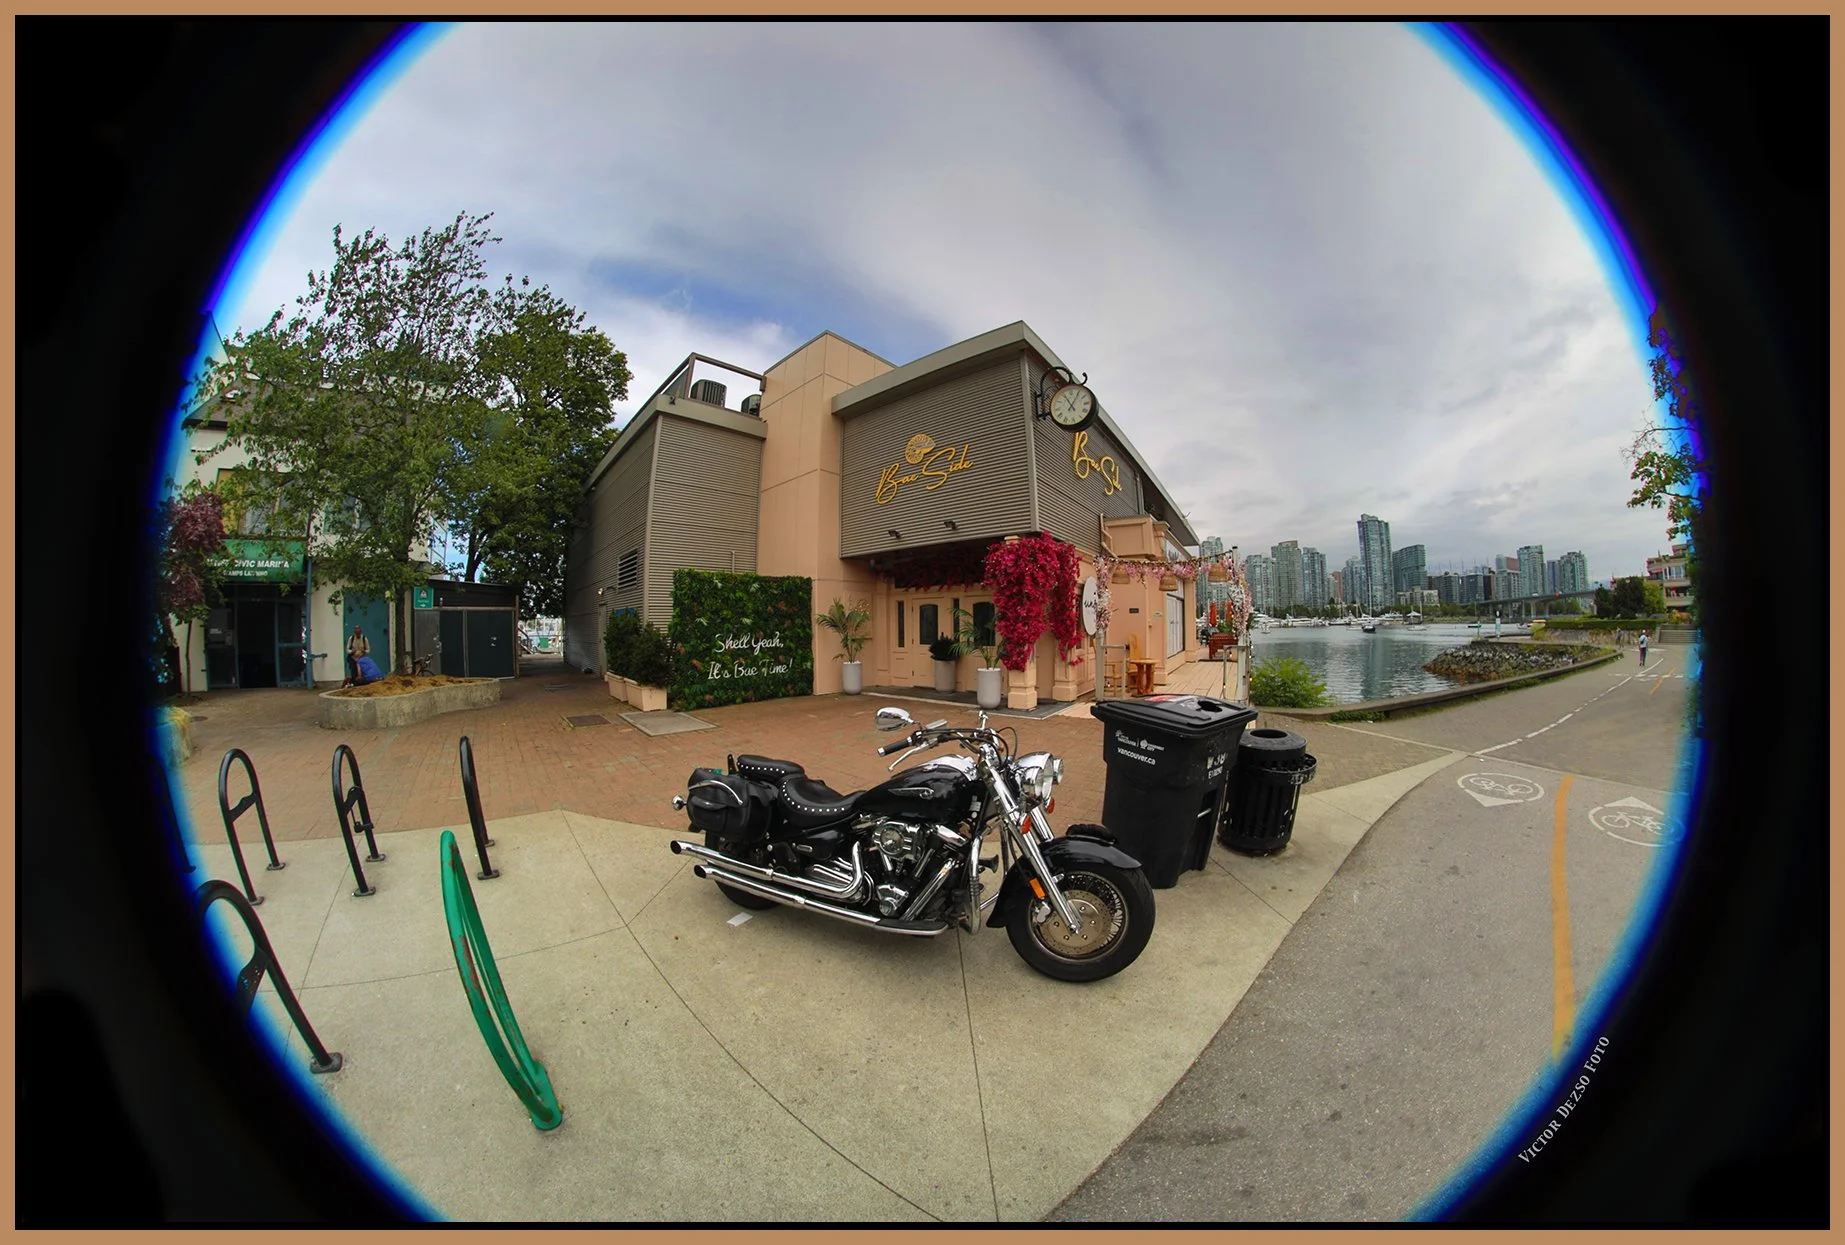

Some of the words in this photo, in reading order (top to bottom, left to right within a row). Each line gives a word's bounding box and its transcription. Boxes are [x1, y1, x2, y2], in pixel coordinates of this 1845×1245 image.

[876, 463, 918, 505] Bae
[922, 444, 974, 490] Side
[715, 632, 750, 653] Shell
[752, 631, 784, 655] Yeah,
[707, 661, 730, 680] It's
[734, 660, 758, 678] Bae
[759, 658, 793, 677] Time!
[1117, 746, 1156, 766] vancouver.ca
